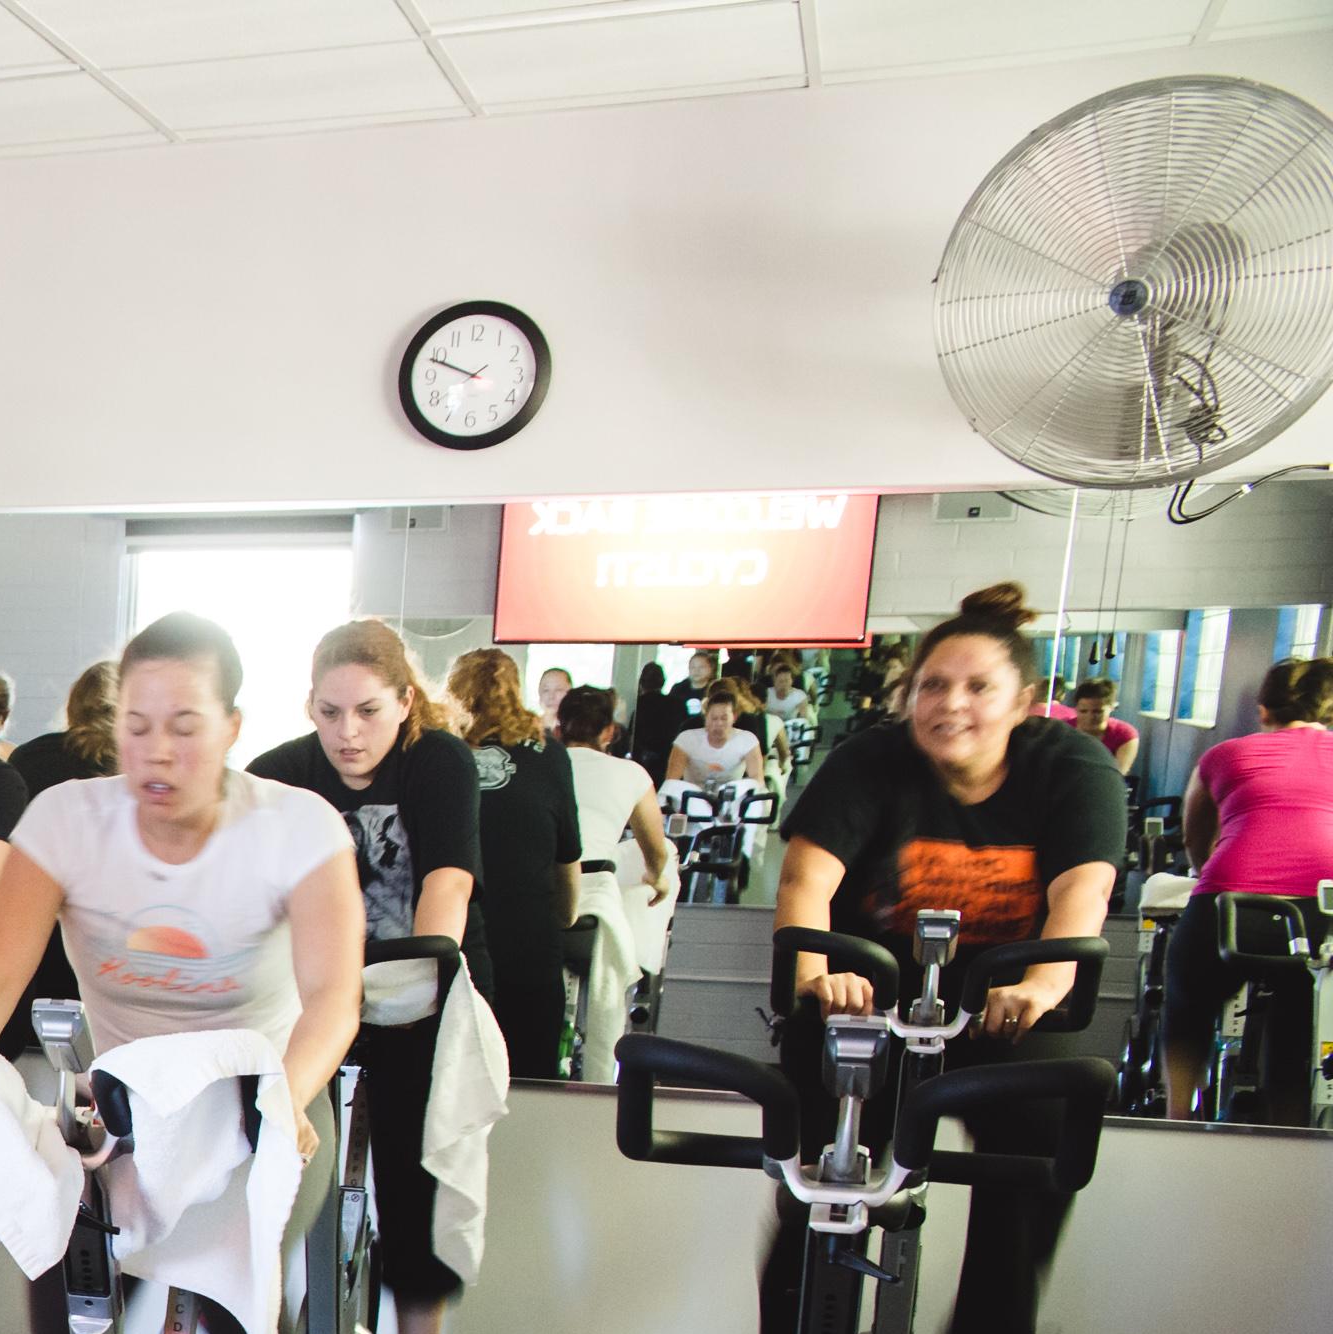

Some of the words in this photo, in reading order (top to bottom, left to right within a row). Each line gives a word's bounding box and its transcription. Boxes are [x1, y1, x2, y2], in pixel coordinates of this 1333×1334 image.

[451, 331, 460, 347] 11
[471, 324, 484, 341] 12
[509, 345, 520, 362] 2
[425, 369, 436, 385] 9
[513, 367, 524, 384] 3
[429, 390, 440, 406] 8
[504, 389, 516, 405] 4
[464, 411, 476, 428] 6
[488, 405, 499, 422] 5
